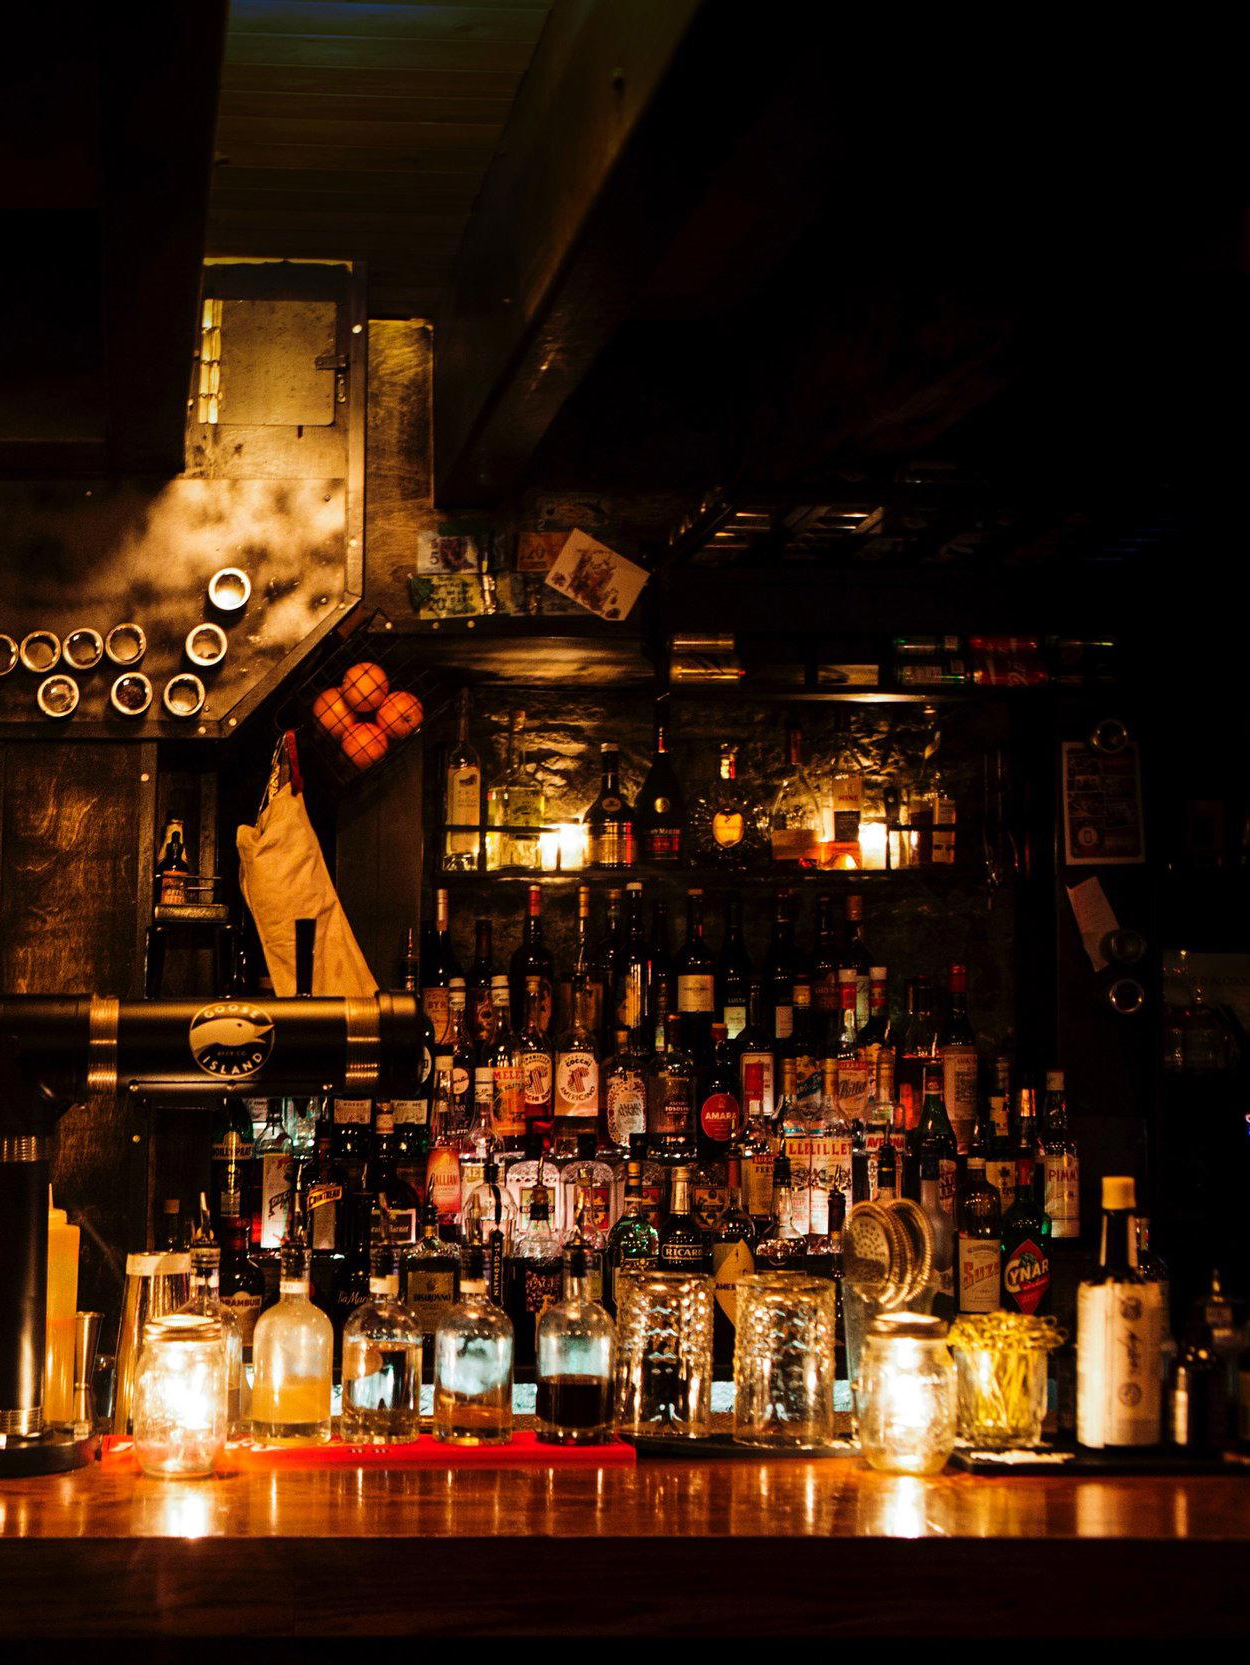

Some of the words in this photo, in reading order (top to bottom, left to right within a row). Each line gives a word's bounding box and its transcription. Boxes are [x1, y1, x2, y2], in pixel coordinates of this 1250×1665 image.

[202, 1004, 261, 1020] GOOSE
[202, 1051, 264, 1075] ISLAND
[565, 1058, 592, 1068] COCCHI
[705, 1112, 738, 1121] AMARA
[493, 1241, 503, 1297] ST-GERMAIN
[1004, 1258, 1049, 1293] CYNAR
